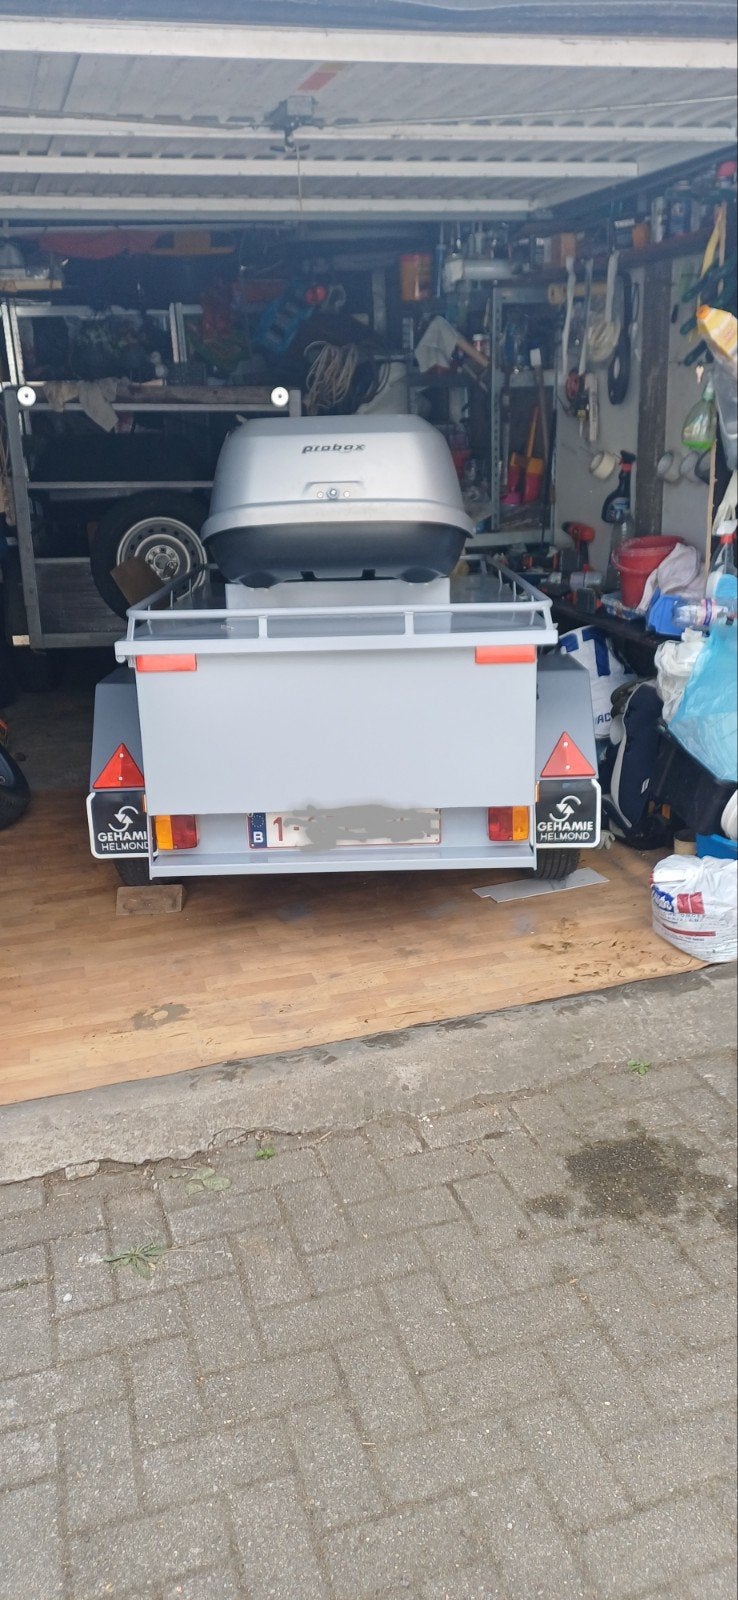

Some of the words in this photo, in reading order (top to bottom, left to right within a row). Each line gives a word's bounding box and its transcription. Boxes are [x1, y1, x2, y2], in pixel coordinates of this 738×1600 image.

[301, 443, 366, 454] probox
[537, 821, 594, 832] GEHAMIE
[97, 831, 148, 842] GEHAMI
[253, 831, 263, 843] B
[540, 831, 590, 841] HELMOND
